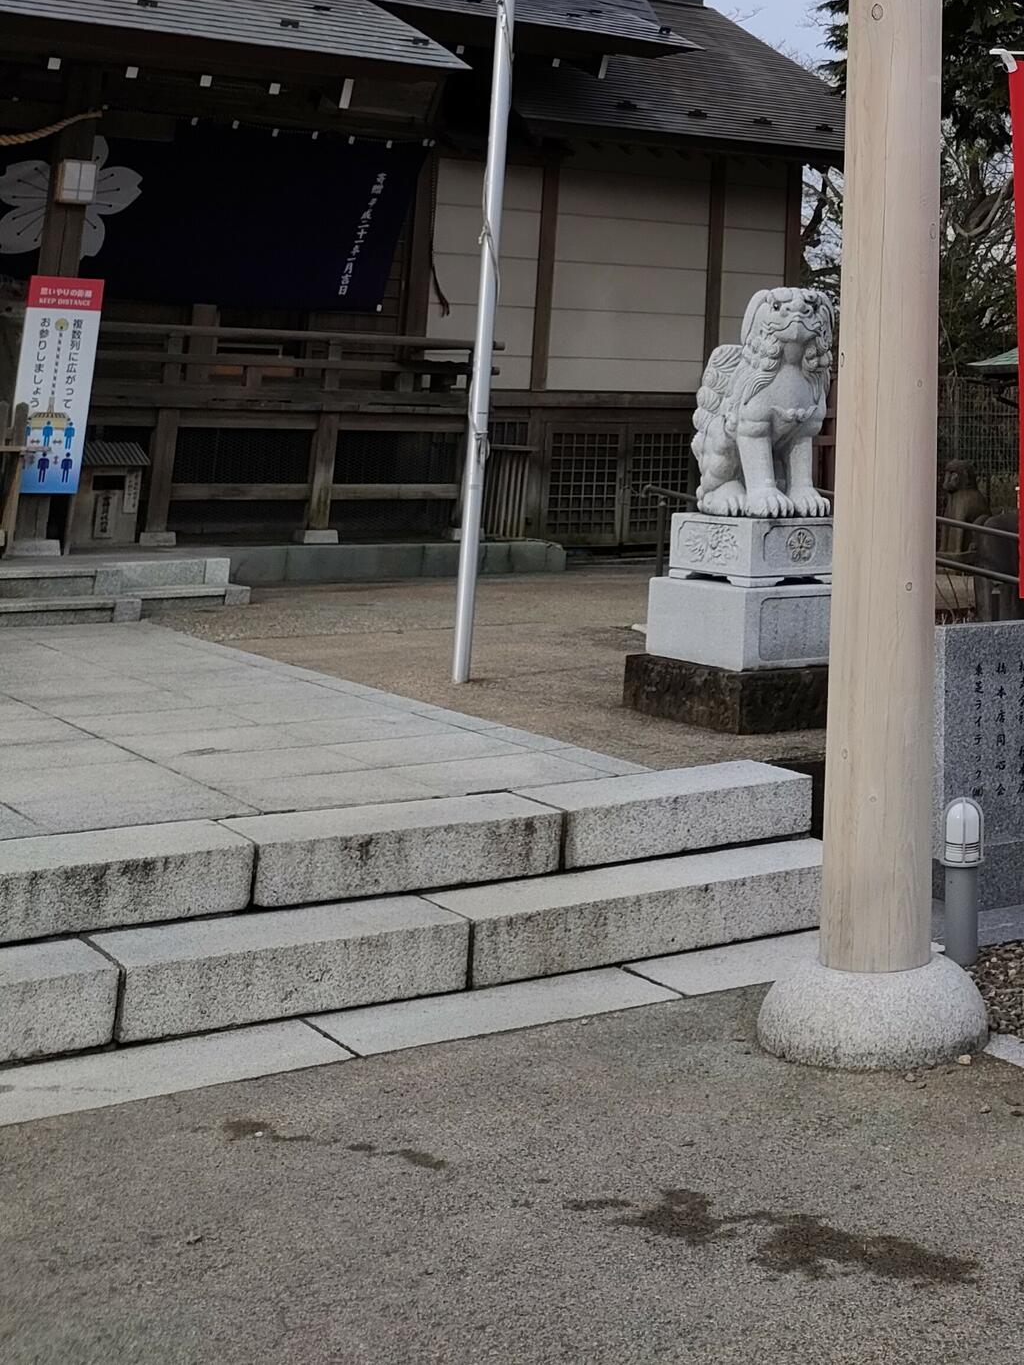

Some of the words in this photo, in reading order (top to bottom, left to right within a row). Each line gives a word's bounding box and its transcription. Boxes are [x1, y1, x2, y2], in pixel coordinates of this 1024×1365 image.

[57, 298, 91, 306] DISTANCE
[30, 317, 51, 408] お参りしましょう
[63, 318, 84, 409] 複数列に広がって
